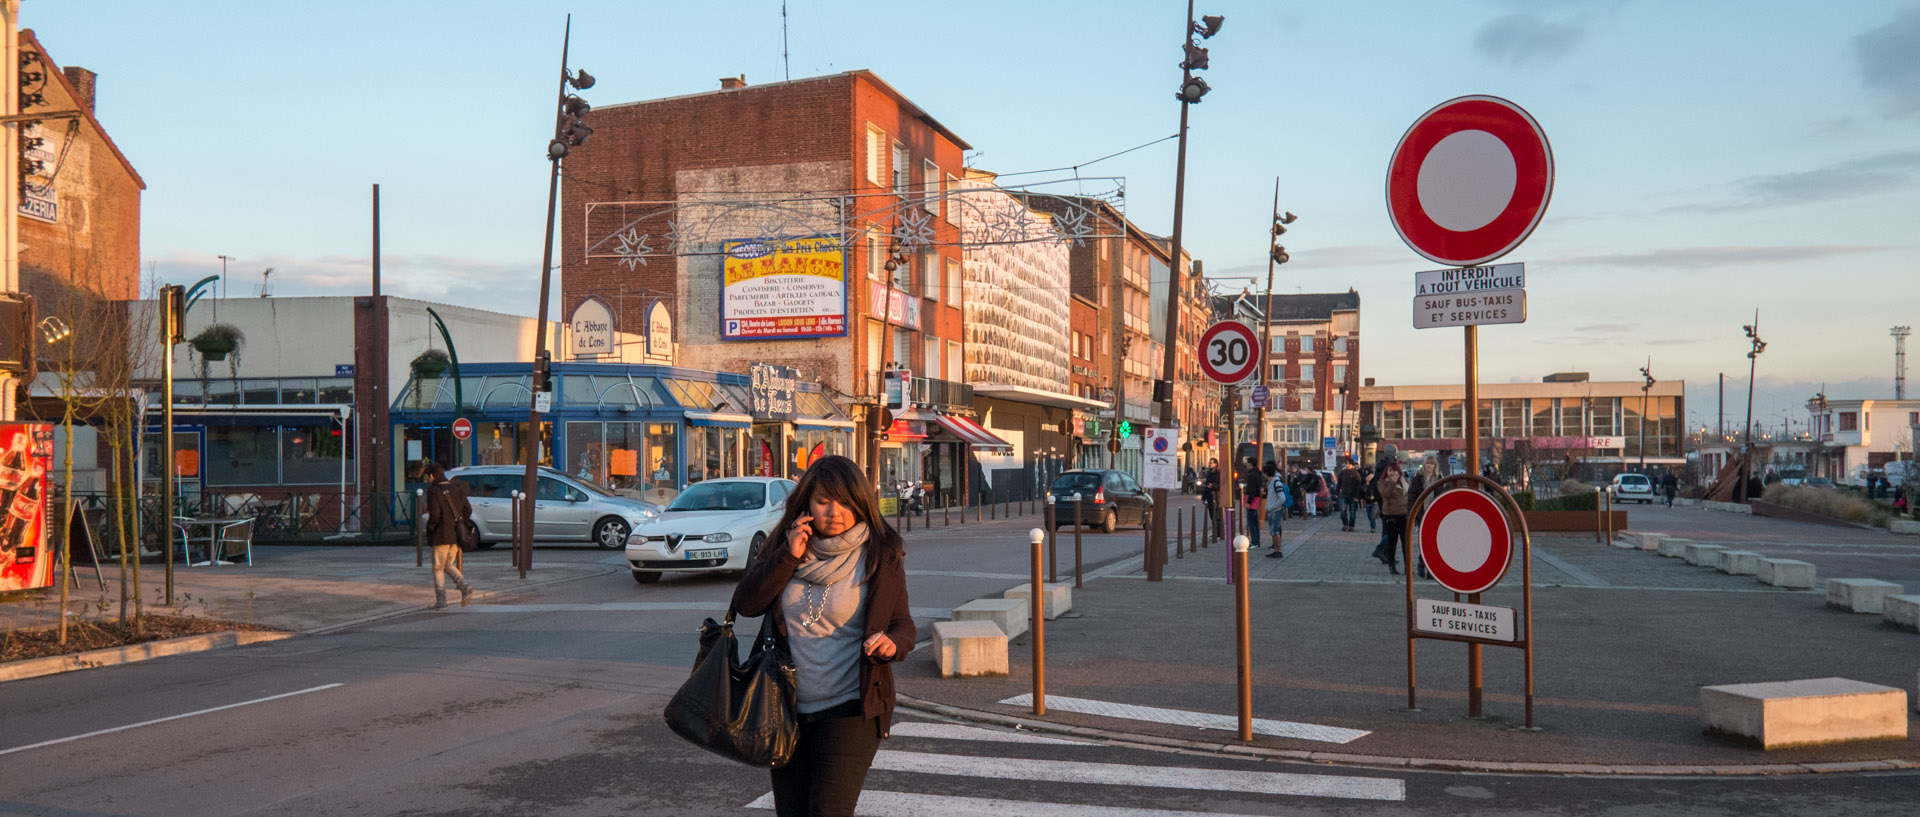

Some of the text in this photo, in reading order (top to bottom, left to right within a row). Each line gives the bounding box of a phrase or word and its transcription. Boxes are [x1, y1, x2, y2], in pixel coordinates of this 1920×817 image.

[727, 256, 842, 282] LE RANCH
[1442, 266, 1496, 281] INTERDIT
[1419, 284, 1426, 294] A
[1431, 281, 1460, 294] TOUT
[1425, 299, 1451, 310] SAUF
[1431, 309, 1507, 323] ET SERVICES
[729, 321, 738, 334] P
[578, 335, 605, 348] de Lens
[1210, 337, 1248, 367] 30
[1432, 605, 1450, 616] SAUF
[1451, 607, 1467, 618] BUS
[1474, 610, 1497, 621] TAXIS
[1431, 618, 1497, 635] ET SERVICES
